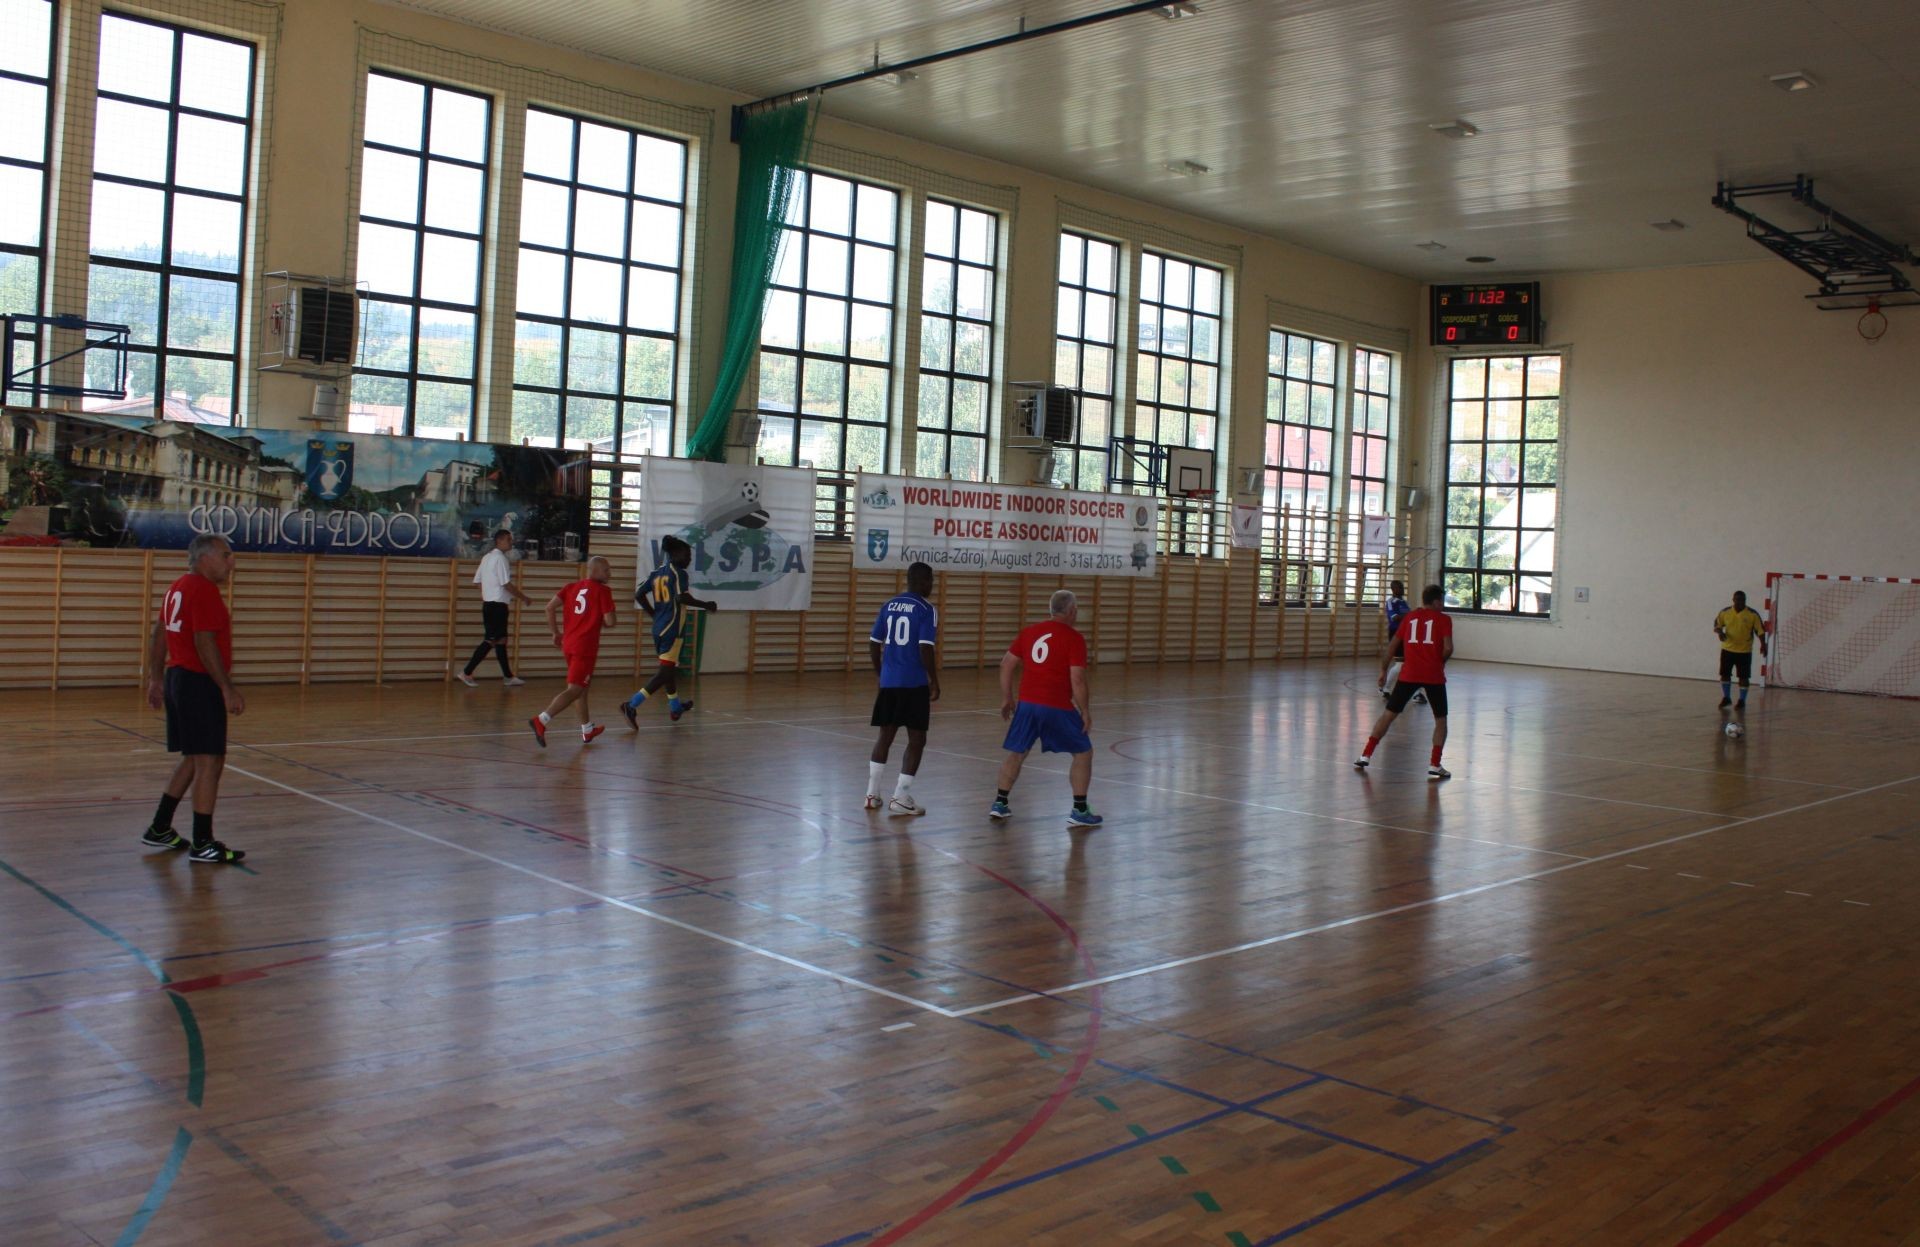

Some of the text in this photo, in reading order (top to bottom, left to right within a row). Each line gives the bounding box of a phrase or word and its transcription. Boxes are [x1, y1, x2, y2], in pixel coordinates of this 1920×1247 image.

[1446, 326, 1457, 341] 0
[1507, 325, 1519, 340] 0
[903, 486, 1125, 519] WORLDWIDE INDOOR SOCCER
[933, 518, 1099, 544] POLICE ASSOCIATION
[901, 546, 988, 569] Krynica-Zdroj,
[991, 549, 1032, 570] August
[1035, 552, 1060, 568] 23rd
[1070, 553, 1093, 569] 31st
[1096, 554, 1122, 569] 2015
[574, 588, 588, 615] 5
[653, 575, 670, 604] 16
[885, 615, 910, 646] 10
[1408, 618, 1434, 645] 11
[1031, 632, 1053, 664] 6
